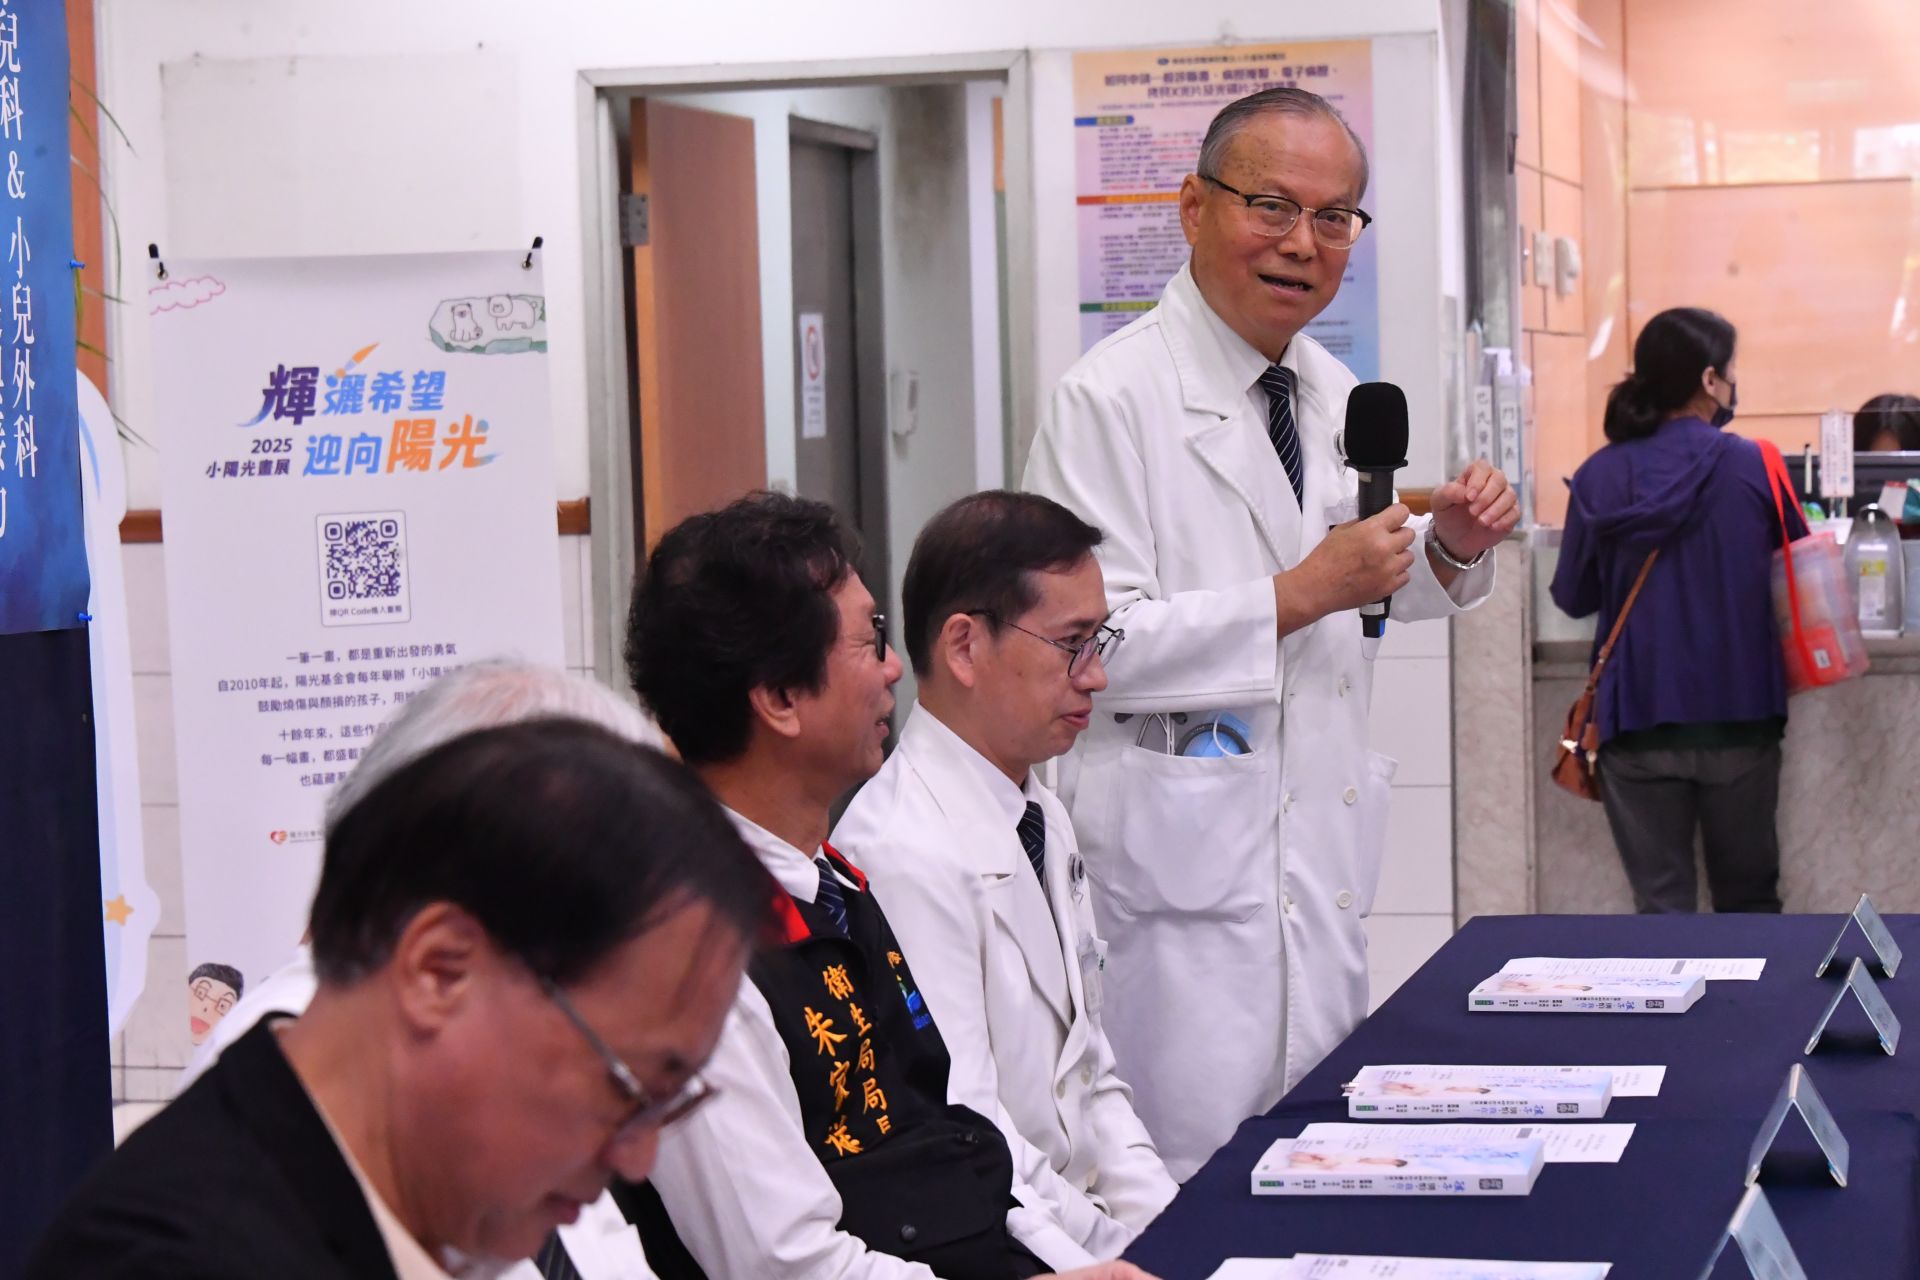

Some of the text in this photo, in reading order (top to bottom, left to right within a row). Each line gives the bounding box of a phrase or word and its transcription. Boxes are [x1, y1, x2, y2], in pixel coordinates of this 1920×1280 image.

[0, 0, 38, 479] 兒科 & 小兒外科
[250, 363, 447, 427] 輝灑希望
[205, 459, 291, 479] 小陽光畫展
[251, 438, 293, 455] 2025
[302, 414, 495, 477] 迎向陽光
